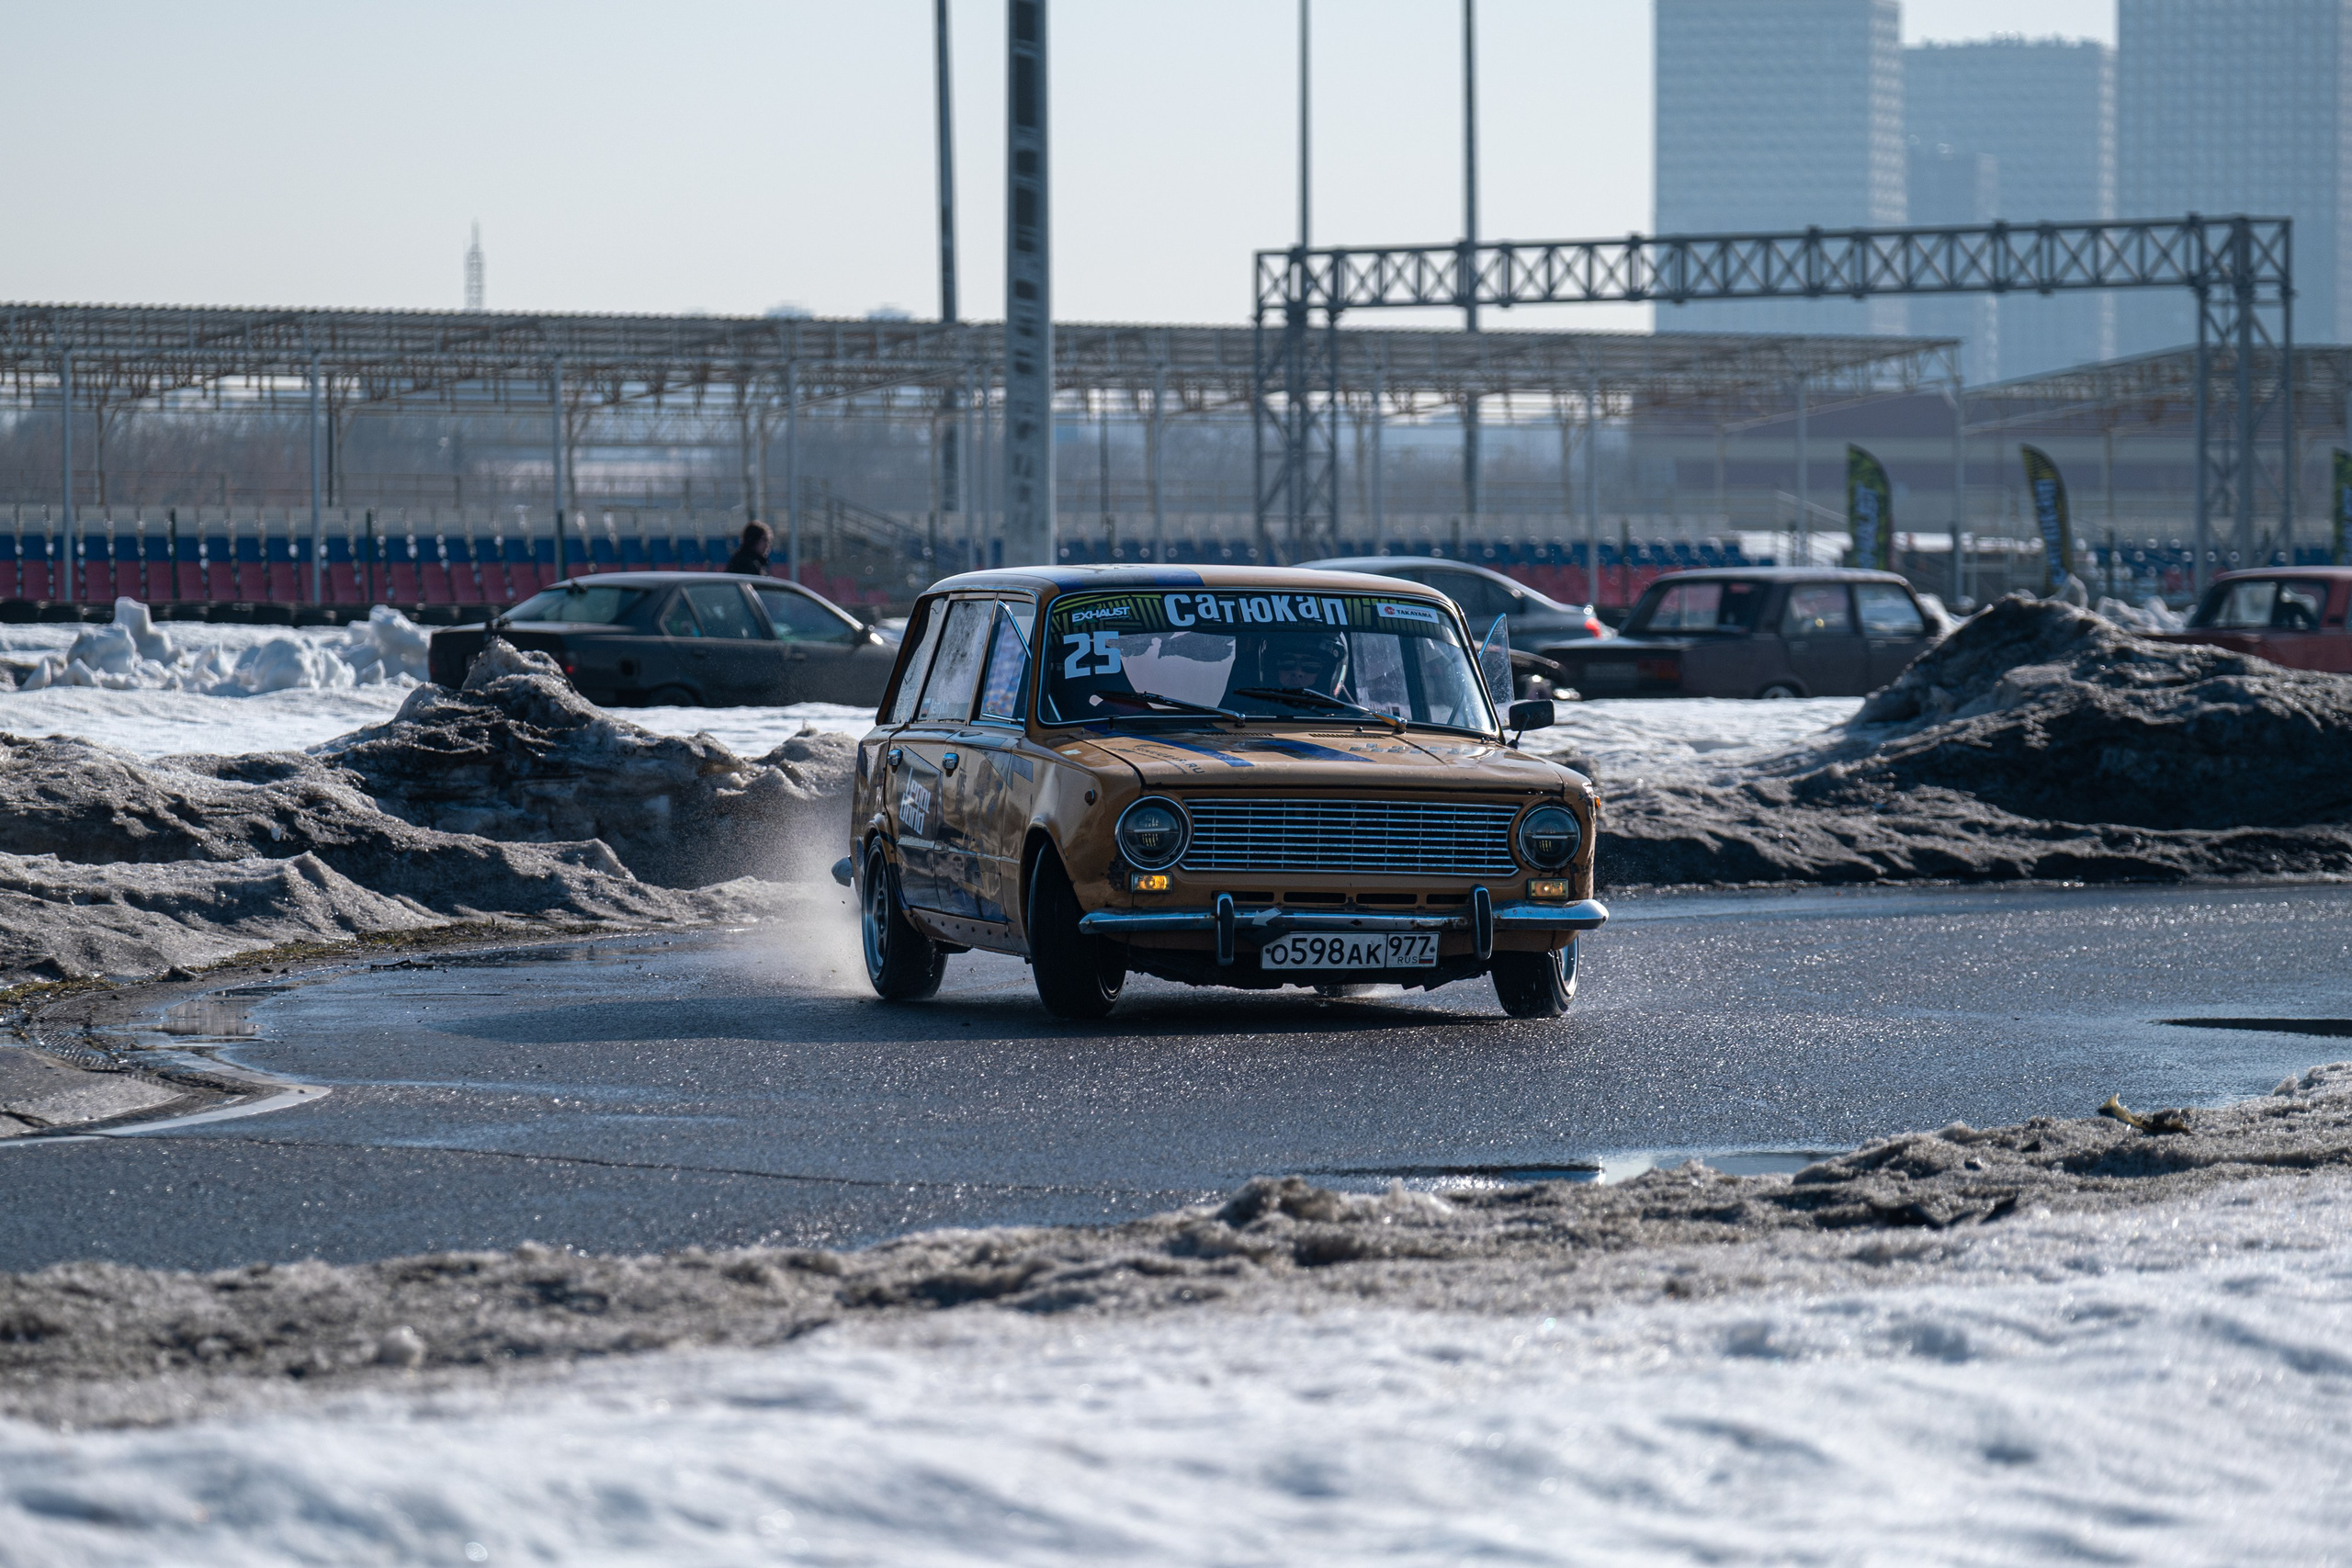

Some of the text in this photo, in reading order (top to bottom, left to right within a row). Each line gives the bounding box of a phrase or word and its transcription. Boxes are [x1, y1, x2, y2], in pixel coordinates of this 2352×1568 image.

[1071, 606, 1130, 623] EXHAUST
[1396, 609, 1433, 618] TAKAYAMA
[1063, 630, 1122, 680] 25
[1388, 935, 1432, 956] 977
[1396, 955, 1419, 964] RUS
